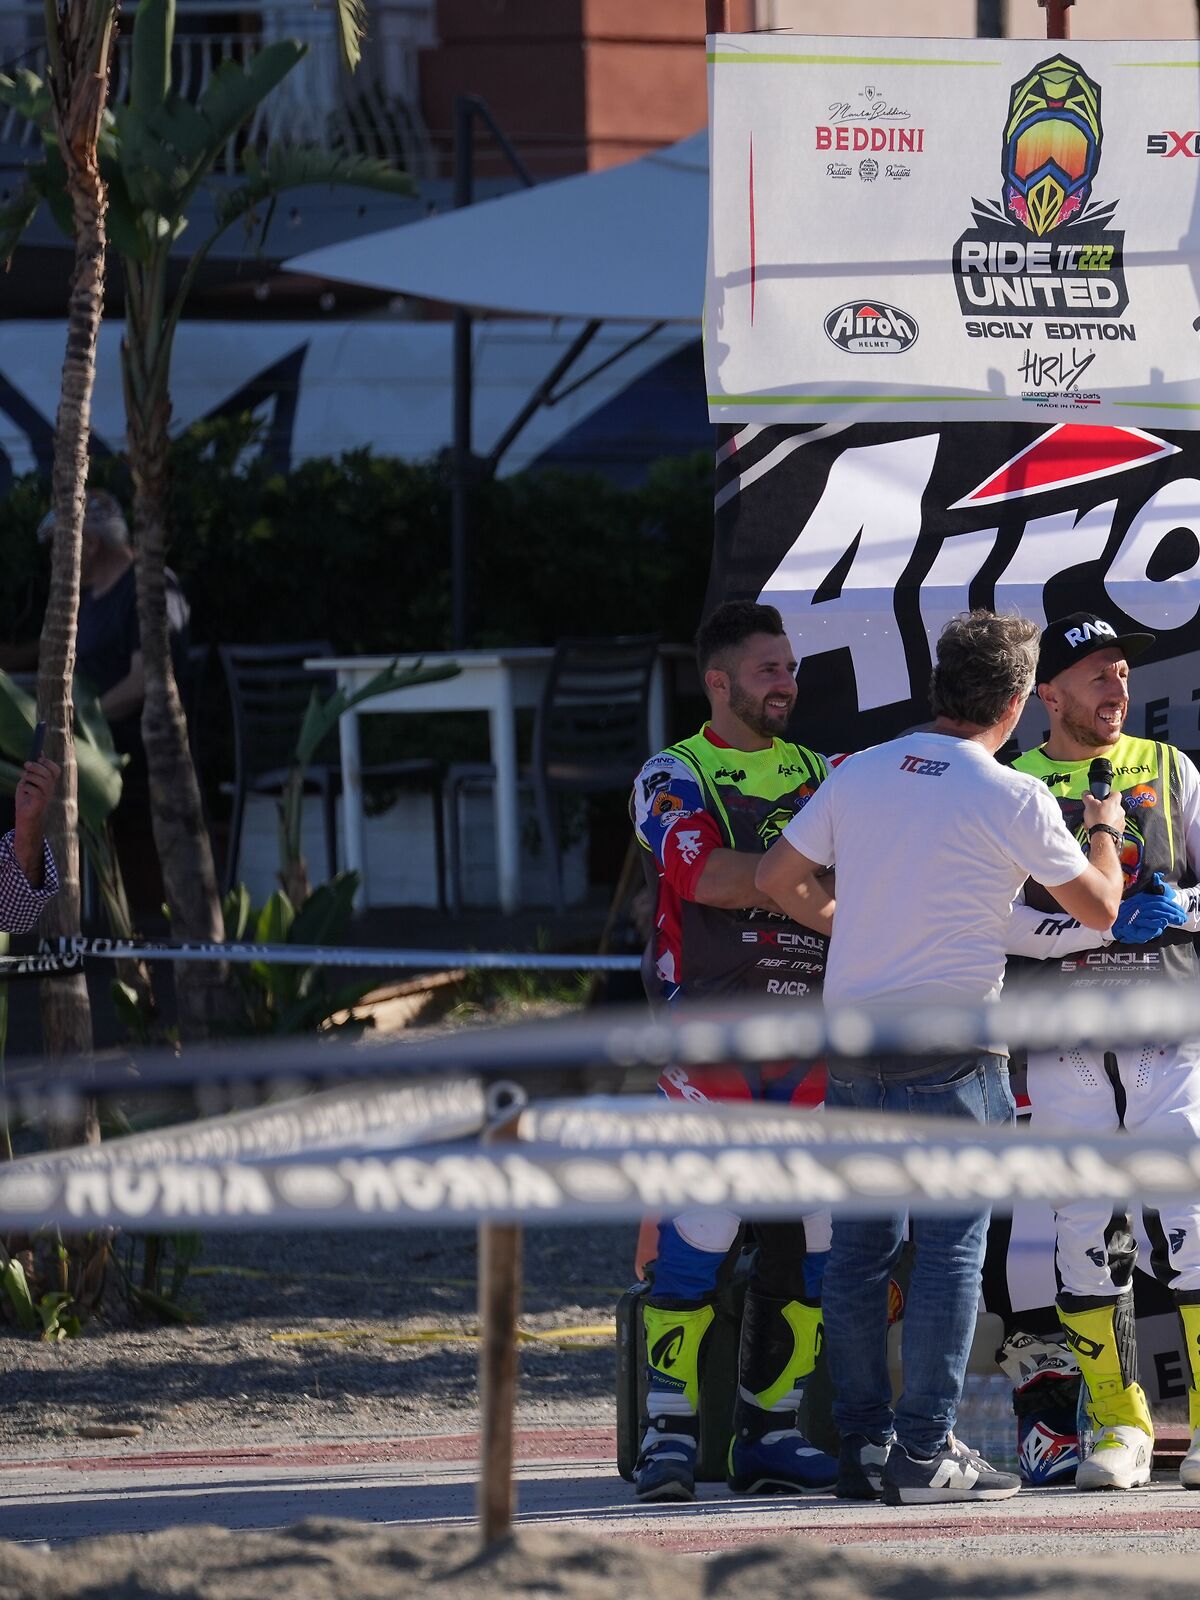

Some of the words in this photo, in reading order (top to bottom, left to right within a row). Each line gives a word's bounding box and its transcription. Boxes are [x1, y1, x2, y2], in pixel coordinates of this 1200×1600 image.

[815, 126, 925, 153] BEDDINI
[960, 241, 1052, 274] RIDE
[1056, 244, 1115, 271] TC222
[962, 276, 1119, 308] UNITED
[831, 306, 914, 340] Airoh
[965, 321, 1033, 339] SICILY
[1045, 322, 1137, 341] EDITION
[899, 754, 951, 777] TC222
[757, 958, 790, 967] ABF
